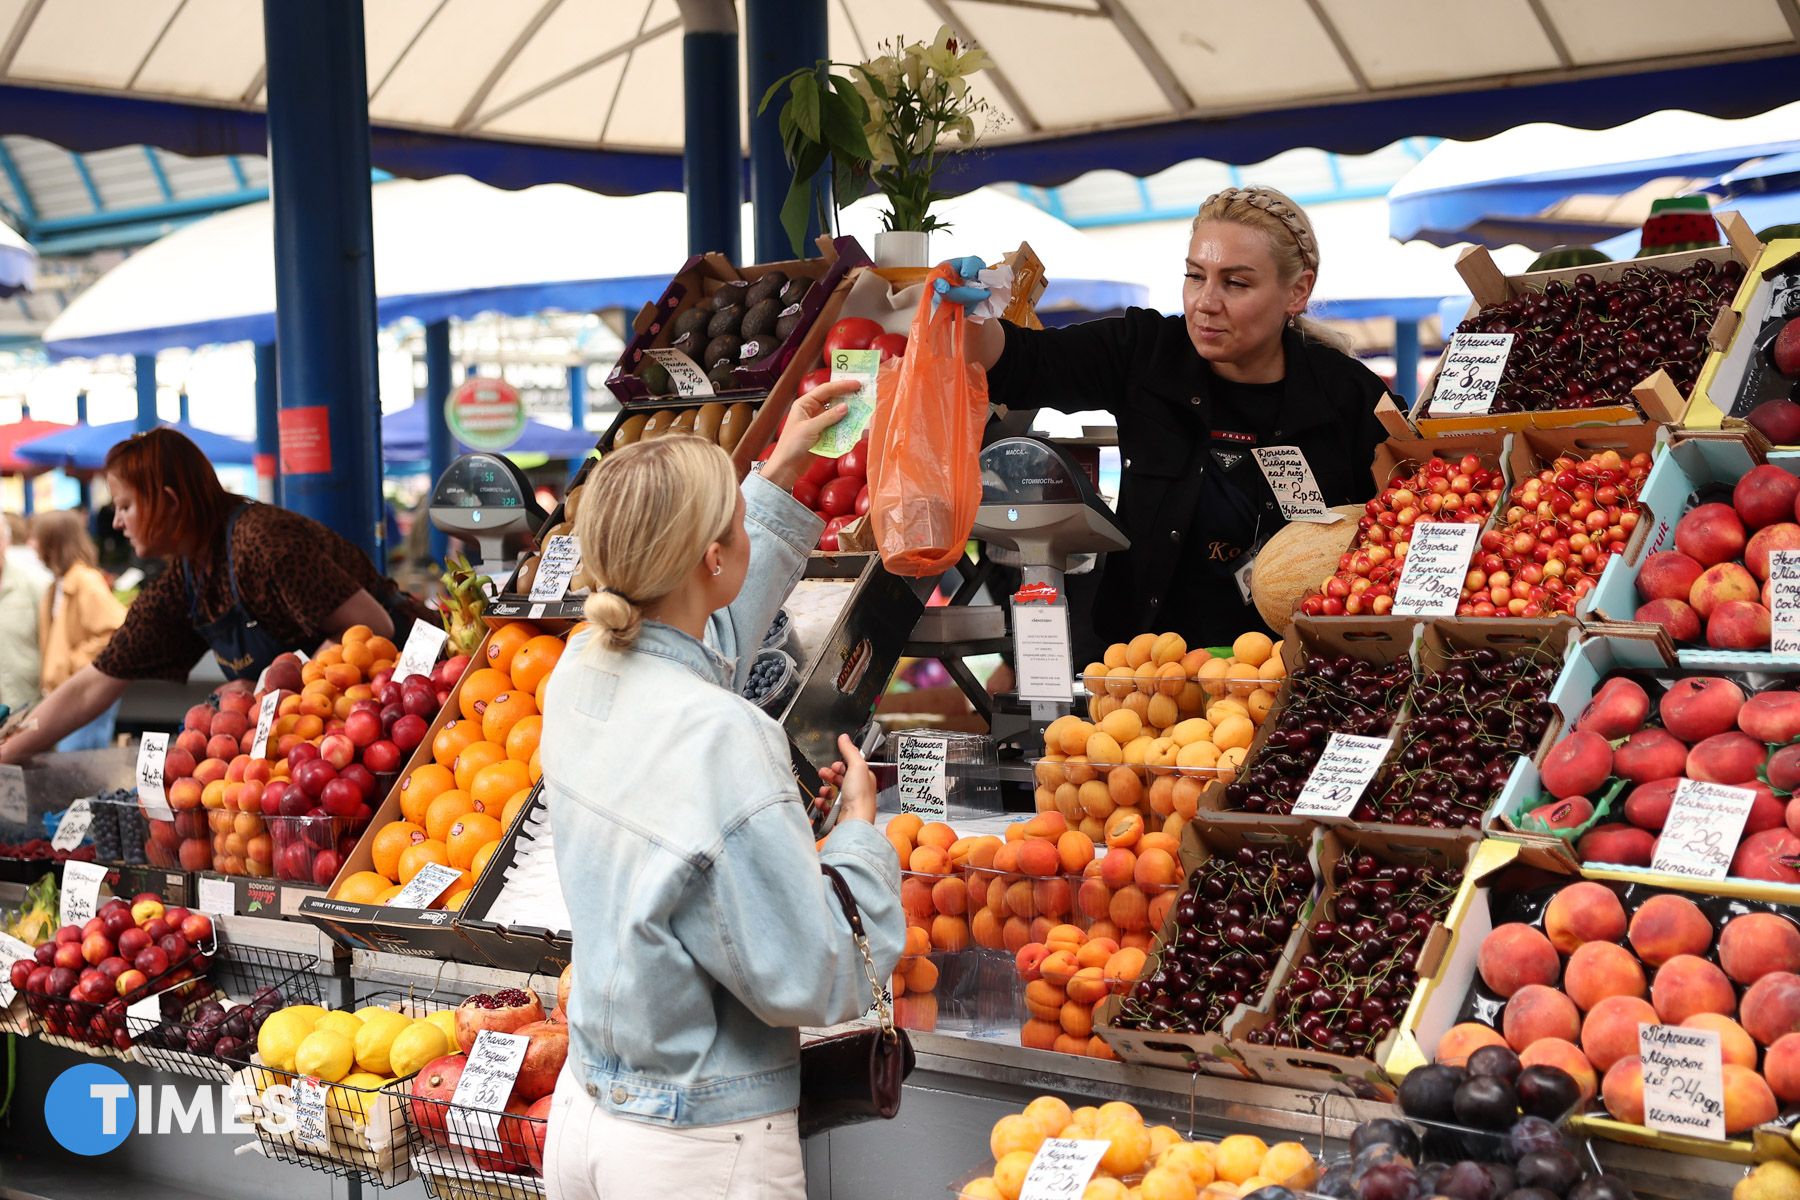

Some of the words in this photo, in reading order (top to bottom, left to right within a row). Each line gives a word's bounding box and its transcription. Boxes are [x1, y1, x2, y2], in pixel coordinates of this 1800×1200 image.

[1455, 335, 1507, 351] Черешня
[837, 354, 849, 371] 50
[1433, 389, 1488, 410] Молдова
[1222, 432, 1251, 441] PRADA
[1262, 458, 1302, 472] Сладкая
[1281, 504, 1323, 520] Узбекистан
[1420, 524, 1466, 539] Черешня
[1412, 538, 1458, 555] Розовая
[1408, 553, 1438, 563] Очень
[1394, 596, 1444, 614] Молдова
[900, 736, 944, 752] Абрикосы
[1335, 735, 1382, 751] Черешня
[899, 750, 944, 762] Королевские
[1681, 781, 1748, 800] Персики
[1294, 802, 1342, 812] Испания
[1653, 859, 1716, 877] Испания
[480, 1030, 515, 1046] Гранат
[1641, 1024, 1706, 1048] Персики
[1641, 1050, 1704, 1076] Медовые
[1649, 1108, 1712, 1128] Испания
